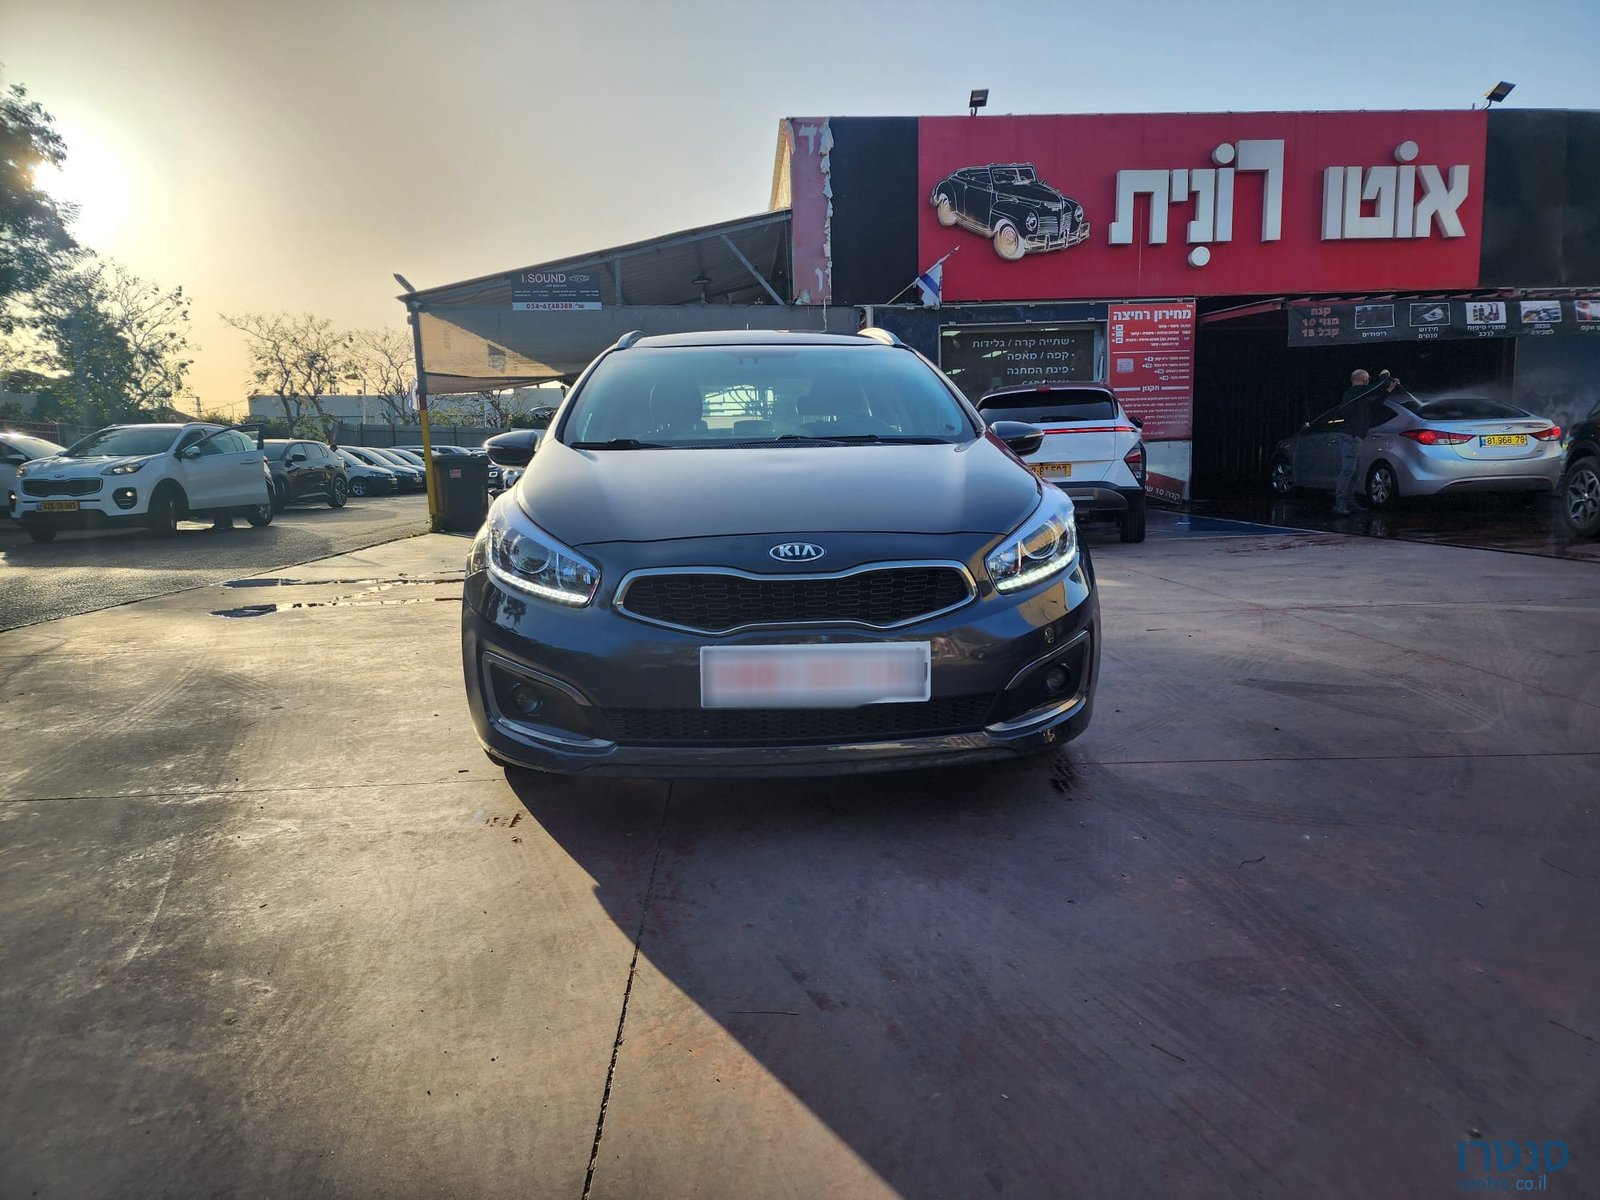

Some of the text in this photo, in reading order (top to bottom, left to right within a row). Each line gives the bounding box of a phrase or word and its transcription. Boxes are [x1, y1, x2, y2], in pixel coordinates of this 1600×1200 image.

[1113, 309, 1192, 323] מחירון רחיצה
[972, 339, 1005, 348] גלידות
[1014, 339, 1036, 348] קרה
[1038, 338, 1070, 346] שתייה
[1007, 351, 1038, 361] מאפה
[1046, 351, 1070, 361] קפה
[1007, 367, 1069, 376] פינת המתנה
[779, 544, 817, 557] KIA
